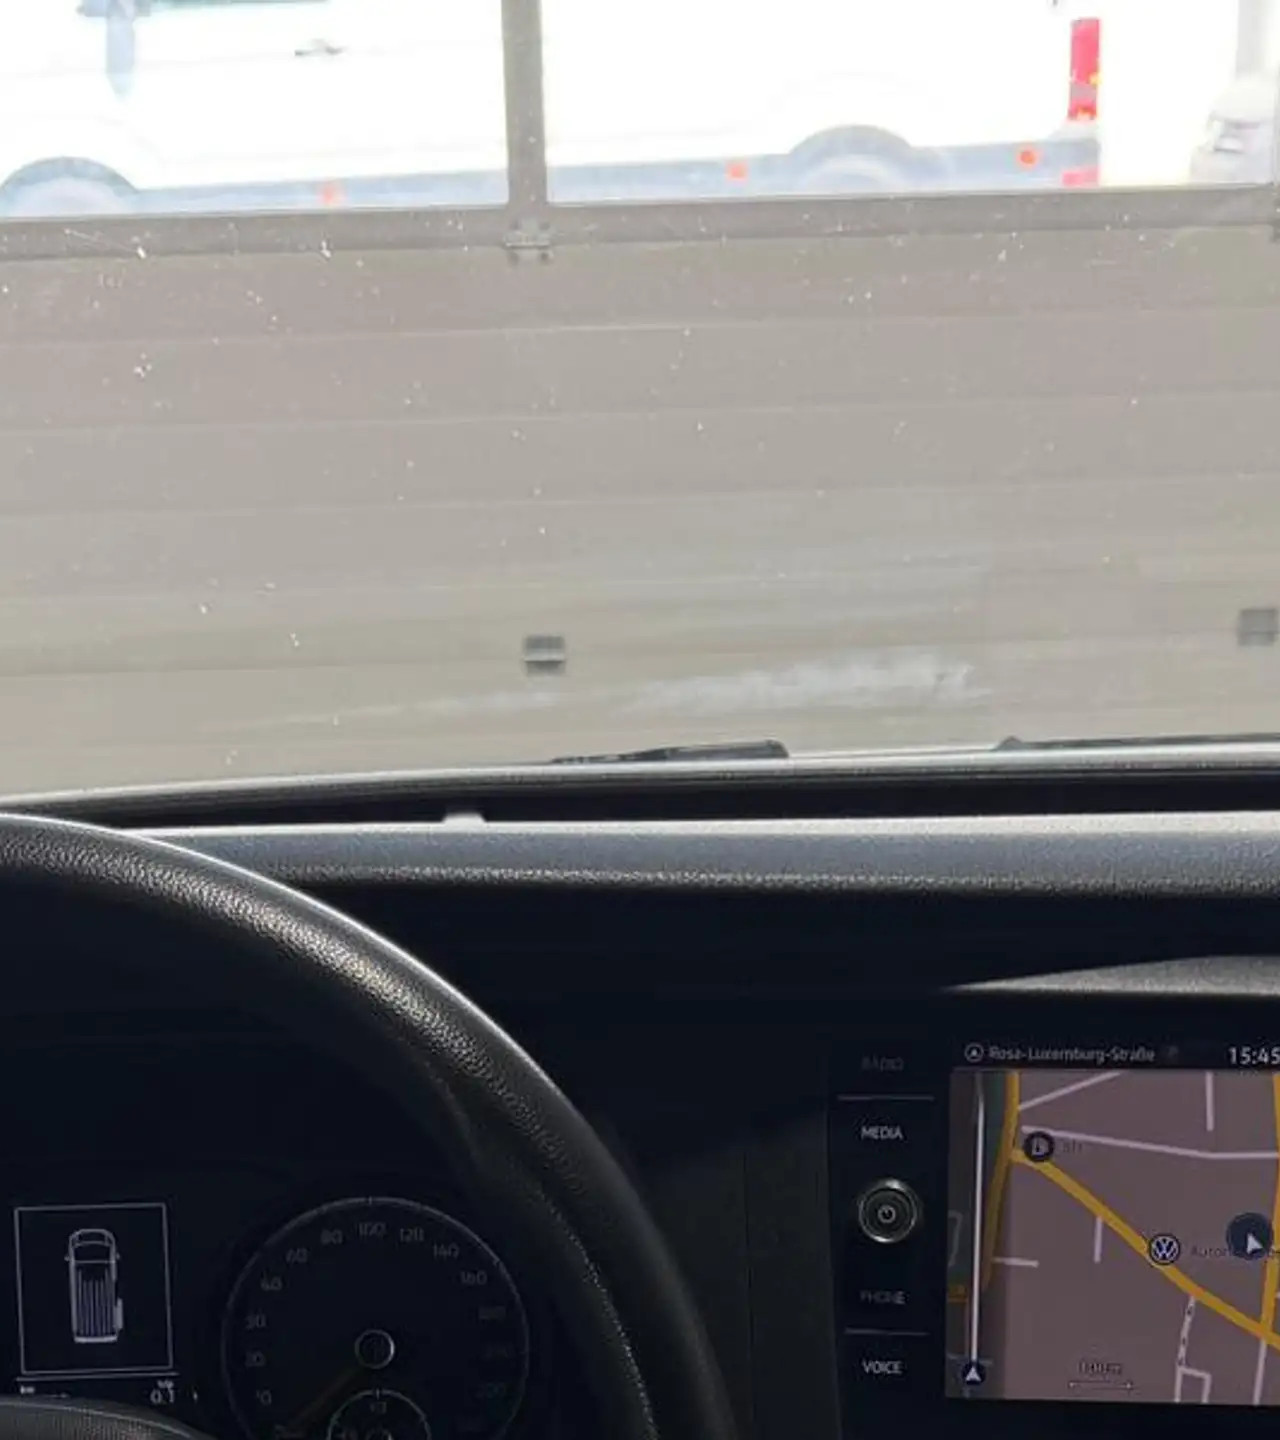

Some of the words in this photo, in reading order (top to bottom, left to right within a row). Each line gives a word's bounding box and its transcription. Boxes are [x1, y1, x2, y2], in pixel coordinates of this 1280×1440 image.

[860, 1125, 903, 1140] MEDIA
[400, 1228, 425, 1243] 120
[432, 1242, 460, 1260] 140
[861, 1359, 904, 1375] VOICE
